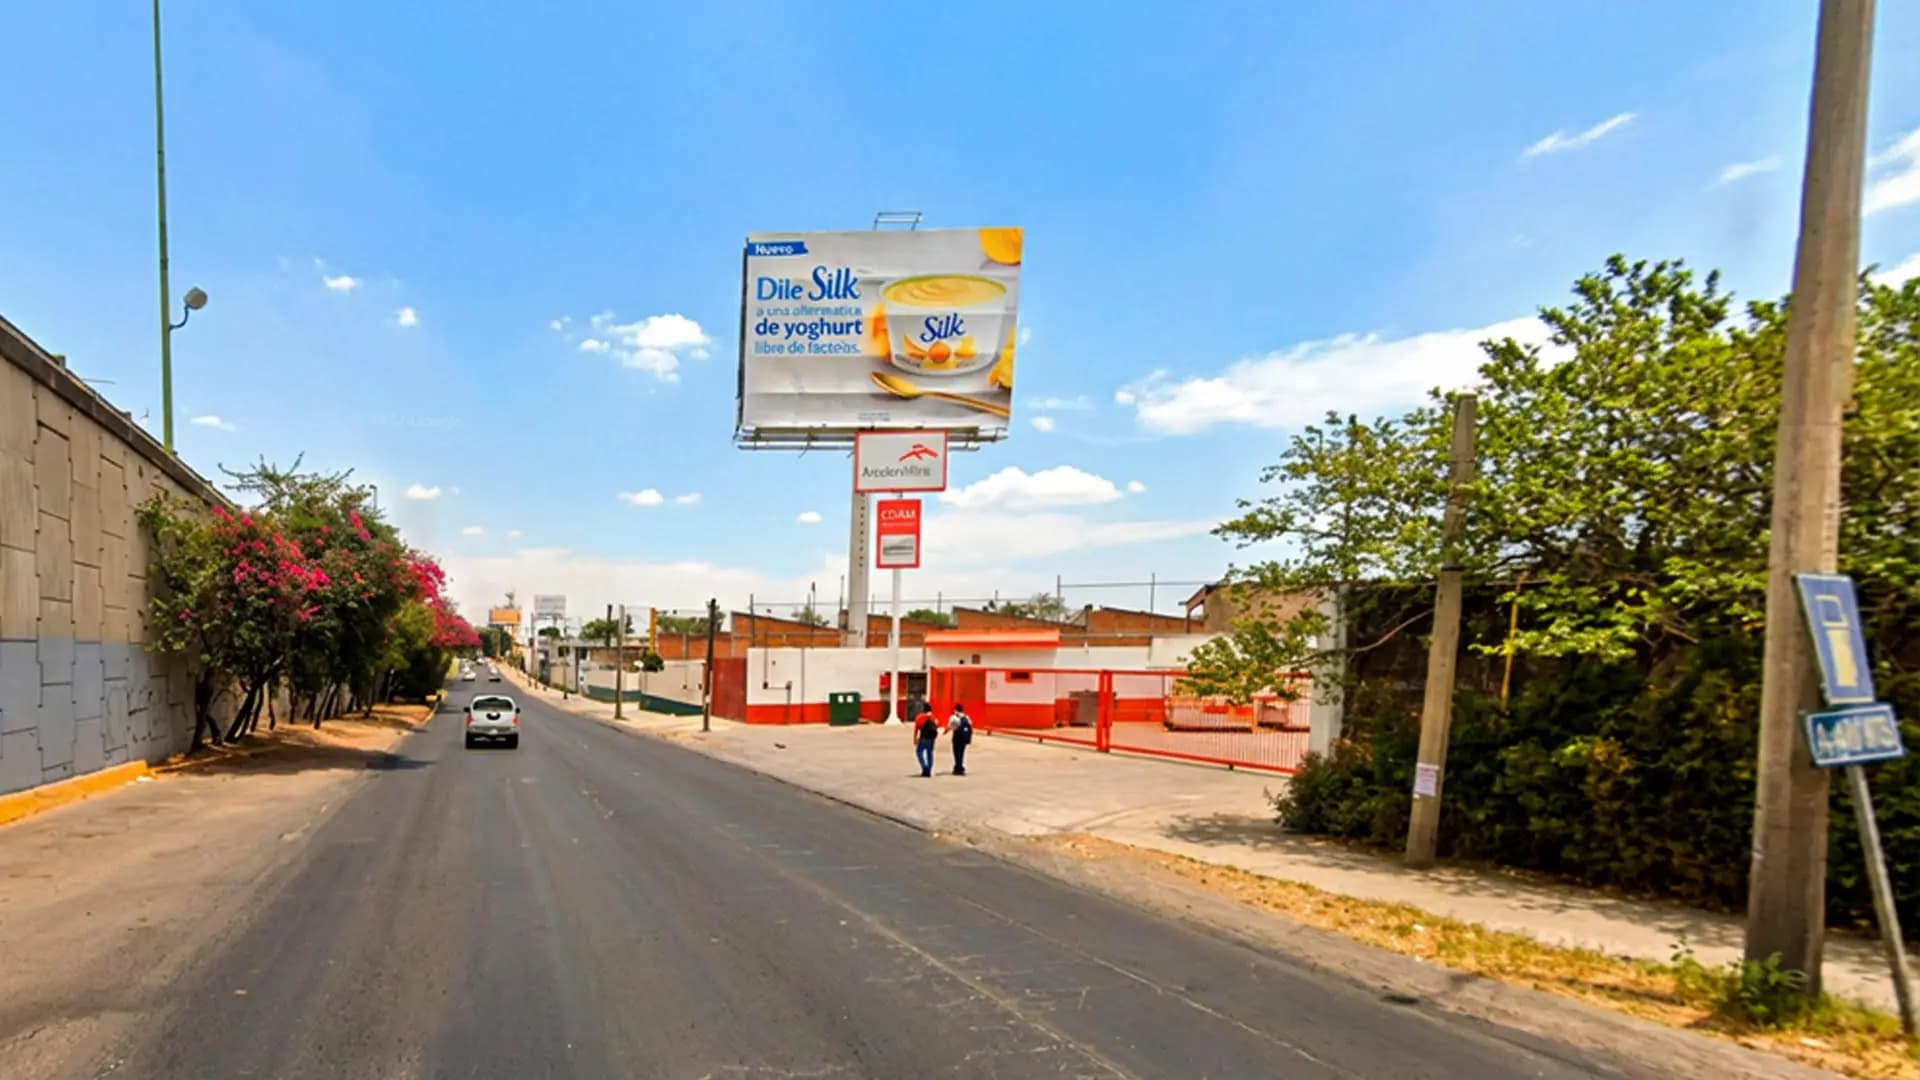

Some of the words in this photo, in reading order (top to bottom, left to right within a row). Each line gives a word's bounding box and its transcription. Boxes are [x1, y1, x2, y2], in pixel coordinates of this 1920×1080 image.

[757, 277, 803, 300] Dile
[808, 265, 860, 301] Silk
[755, 317, 779, 335] de
[784, 317, 863, 340] yoghurt
[920, 312, 966, 343] Silk
[755, 341, 785, 354] libre
[787, 341, 805, 354] de
